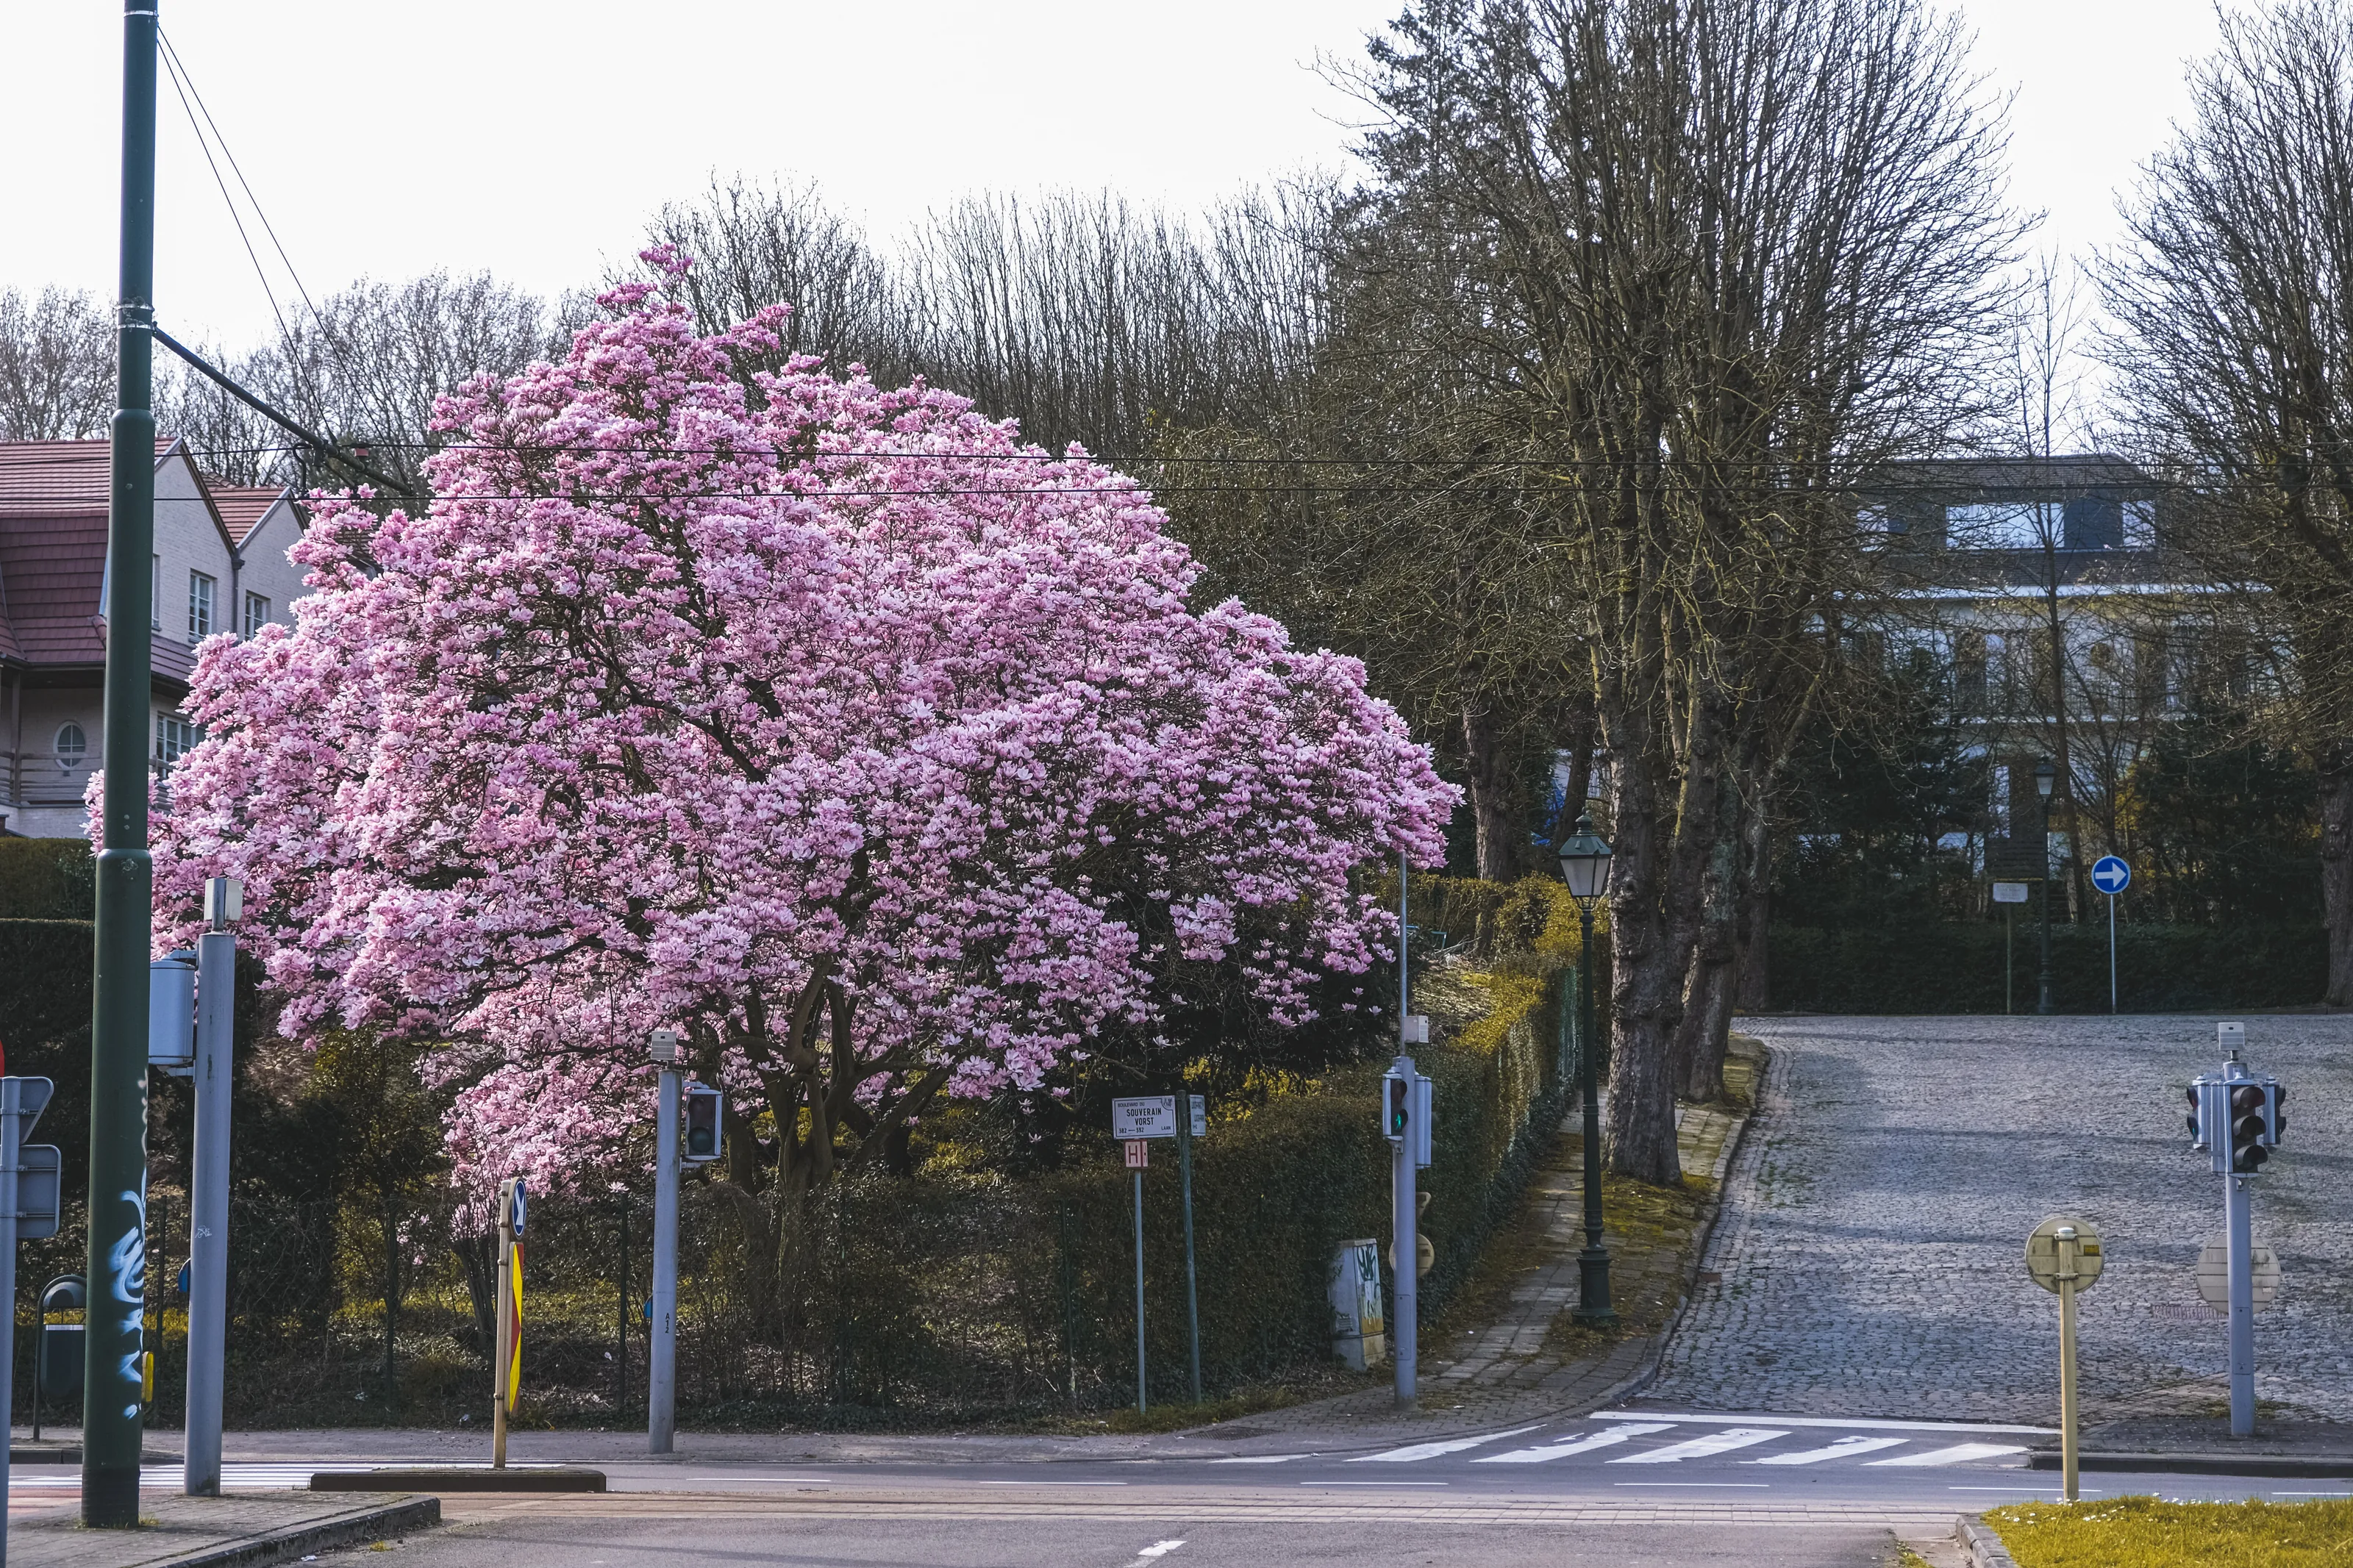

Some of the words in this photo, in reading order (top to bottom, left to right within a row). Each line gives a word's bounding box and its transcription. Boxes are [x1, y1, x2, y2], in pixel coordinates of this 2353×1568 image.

[1126, 1108, 1161, 1117] SOUVERAIN
[1135, 1117, 1154, 1125] VORST
[1128, 1145, 1138, 1164] H
